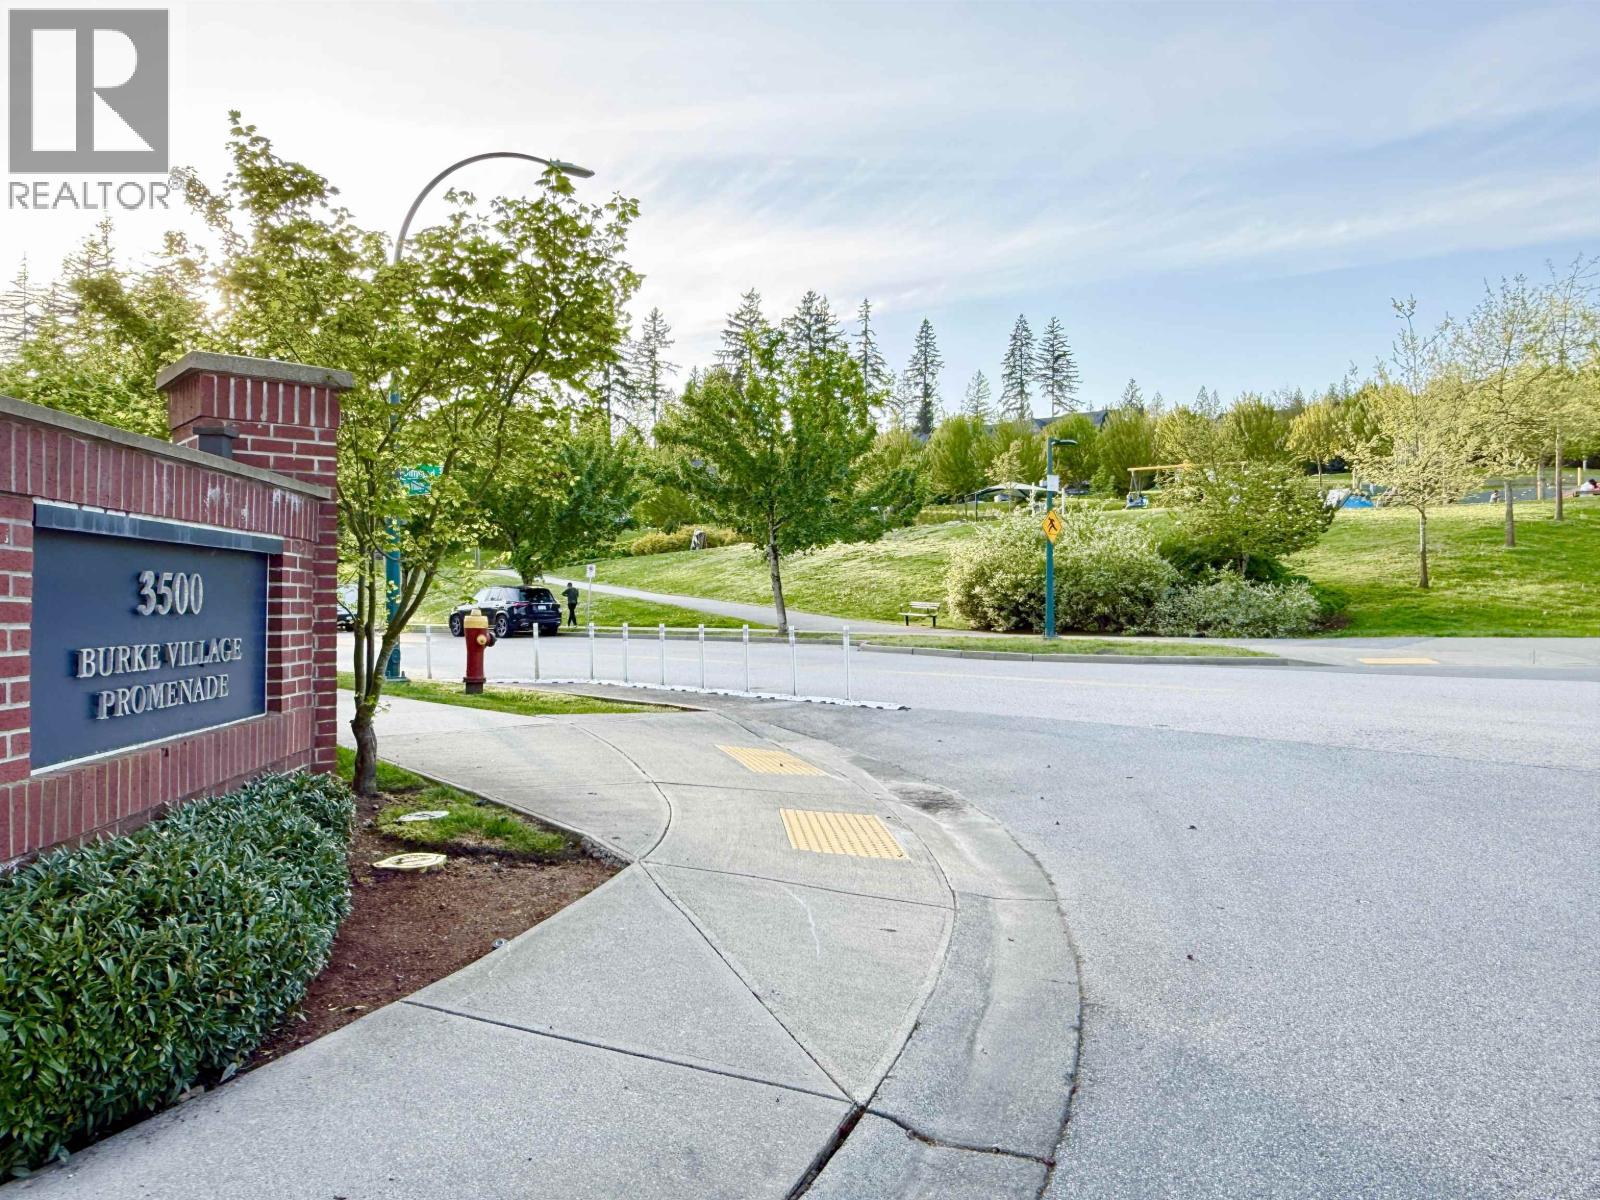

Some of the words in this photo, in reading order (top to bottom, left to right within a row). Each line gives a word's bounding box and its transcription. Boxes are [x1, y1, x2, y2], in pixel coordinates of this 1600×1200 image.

[136, 570, 204, 616] 3500
[75, 643, 162, 679] BURKE
[165, 637, 243, 670] VILLAGE
[95, 673, 230, 720] PROMENADE
